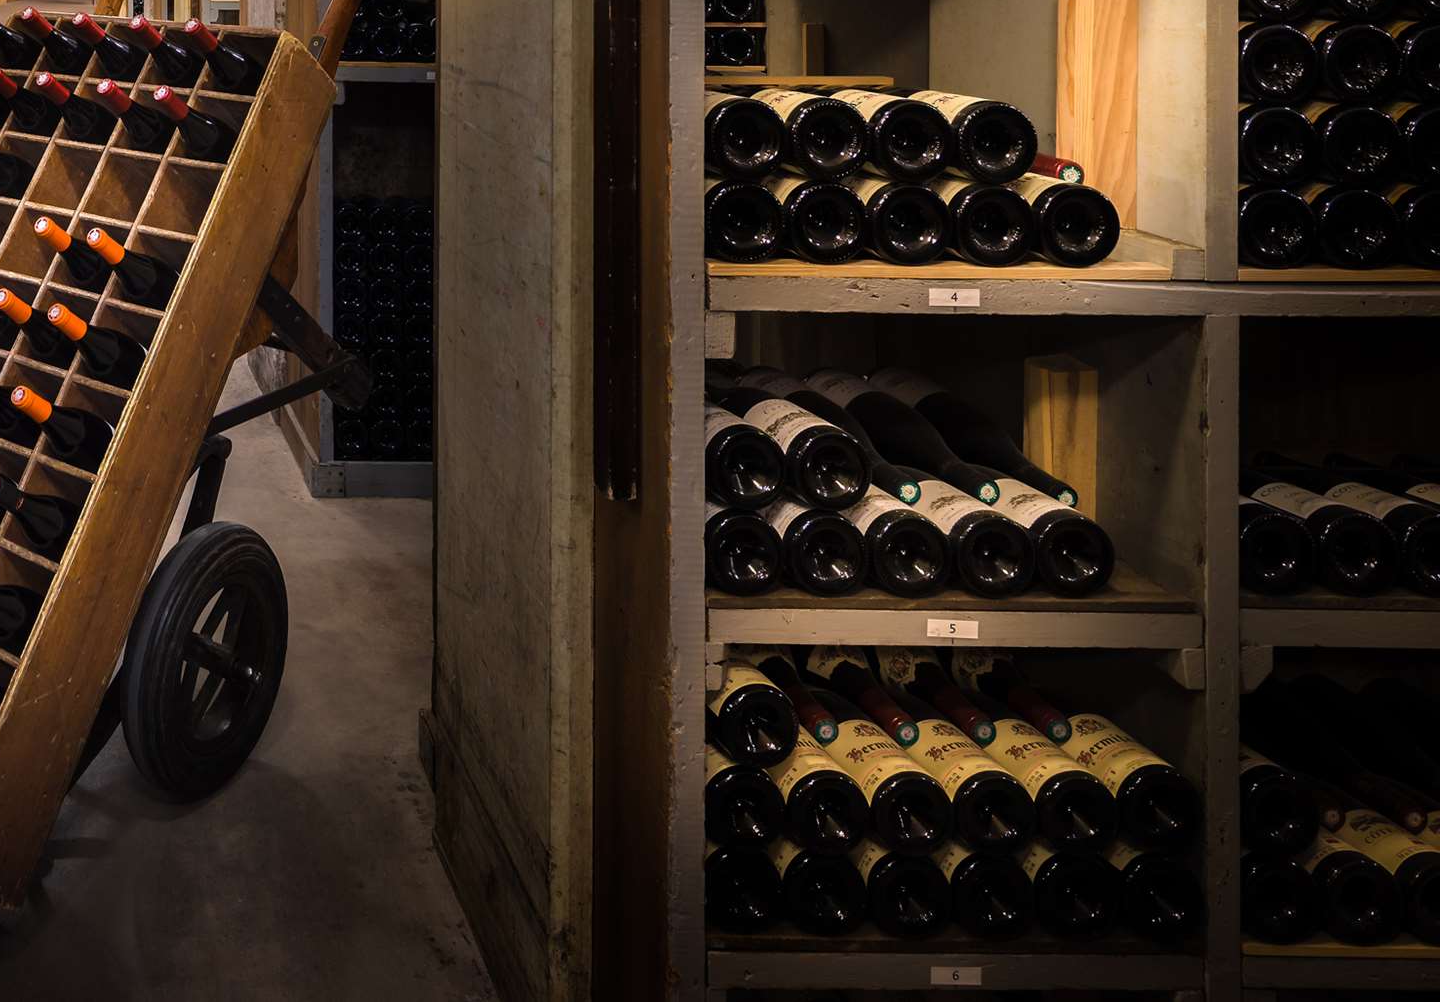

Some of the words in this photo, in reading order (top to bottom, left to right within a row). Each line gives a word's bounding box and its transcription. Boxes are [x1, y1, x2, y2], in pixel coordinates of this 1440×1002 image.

[951, 292, 958, 302] 4
[949, 623, 956, 634] 5
[953, 971, 959, 981] 6
